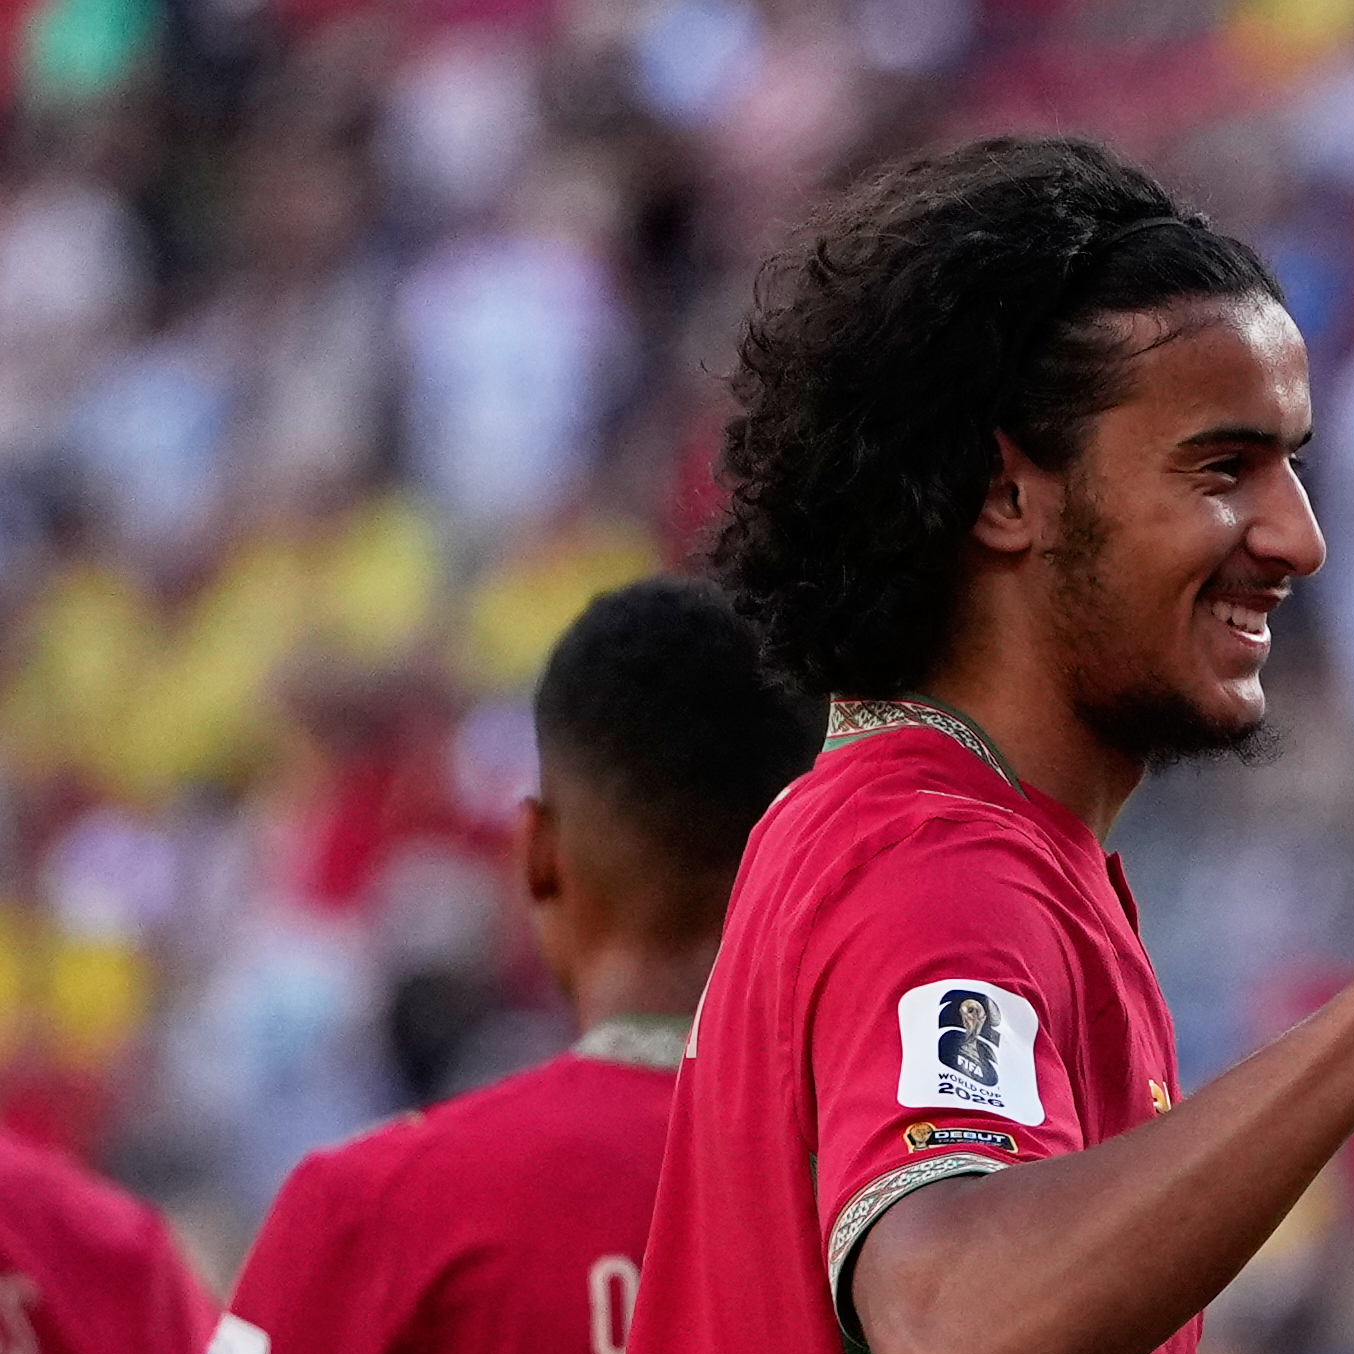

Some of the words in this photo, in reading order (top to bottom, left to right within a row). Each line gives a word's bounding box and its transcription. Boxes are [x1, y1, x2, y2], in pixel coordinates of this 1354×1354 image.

[957, 1054, 984, 1078] FIFA
[938, 1073, 977, 1092] WORLD
[979, 1088, 1002, 1099] CUP
[938, 1082, 1006, 1108] 2026
[934, 1130, 1007, 1143] DEBUT
